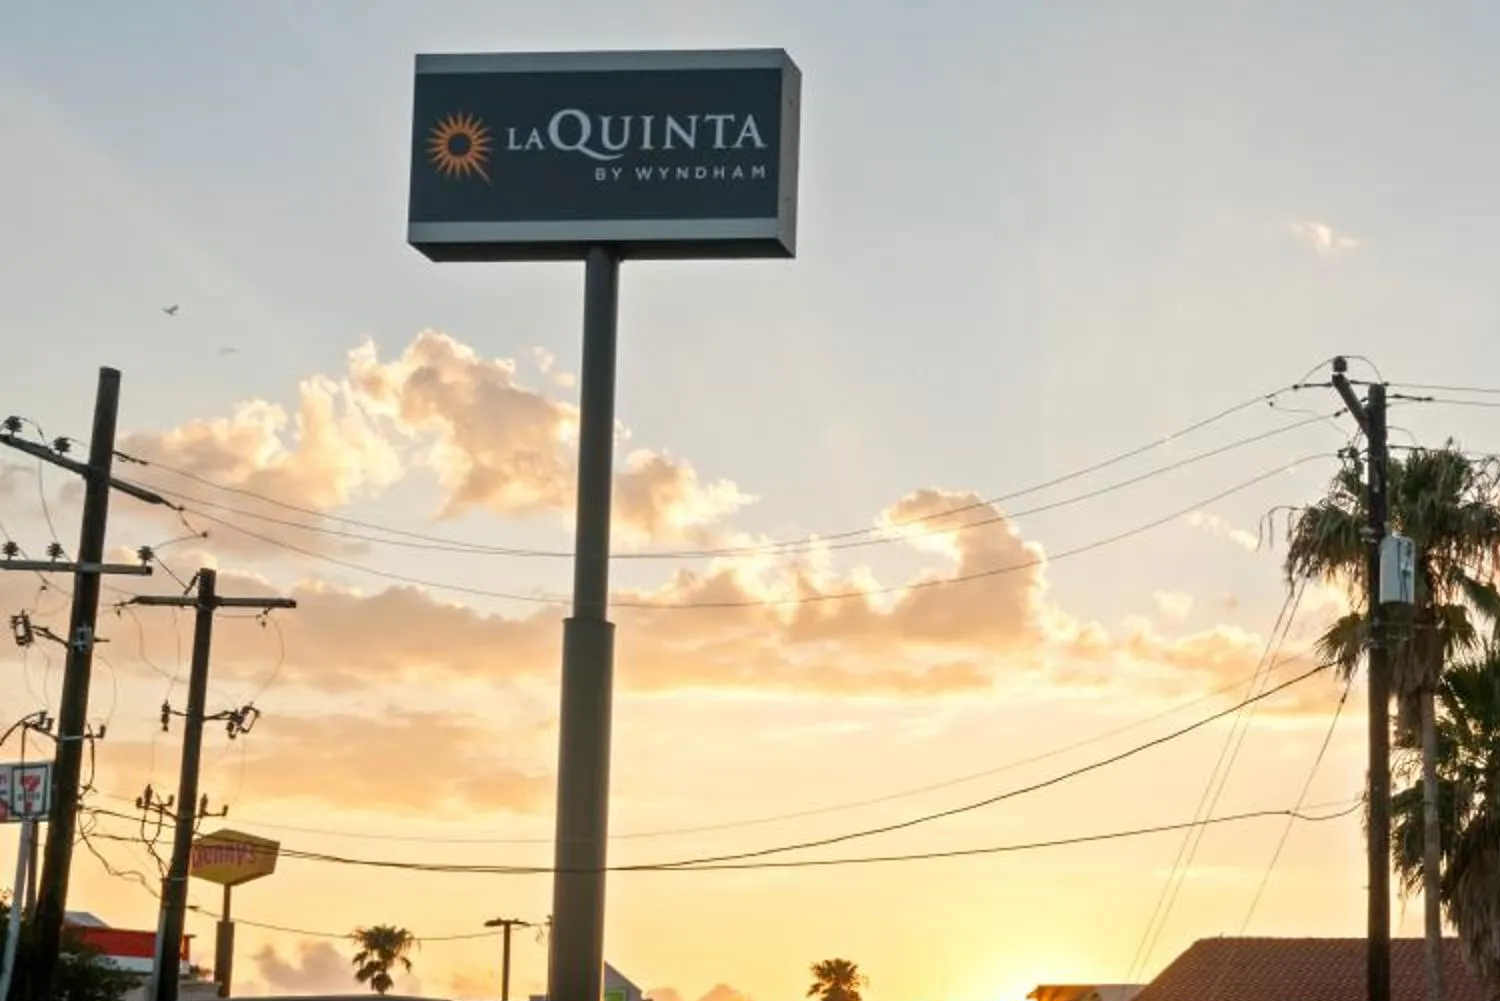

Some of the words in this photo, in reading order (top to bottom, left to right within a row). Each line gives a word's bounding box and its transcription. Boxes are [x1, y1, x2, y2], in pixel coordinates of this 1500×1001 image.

[507, 127, 545, 151] LA
[547, 108, 768, 161] QUINTA
[595, 167, 623, 181] BY
[636, 165, 766, 180] WYNDHAM
